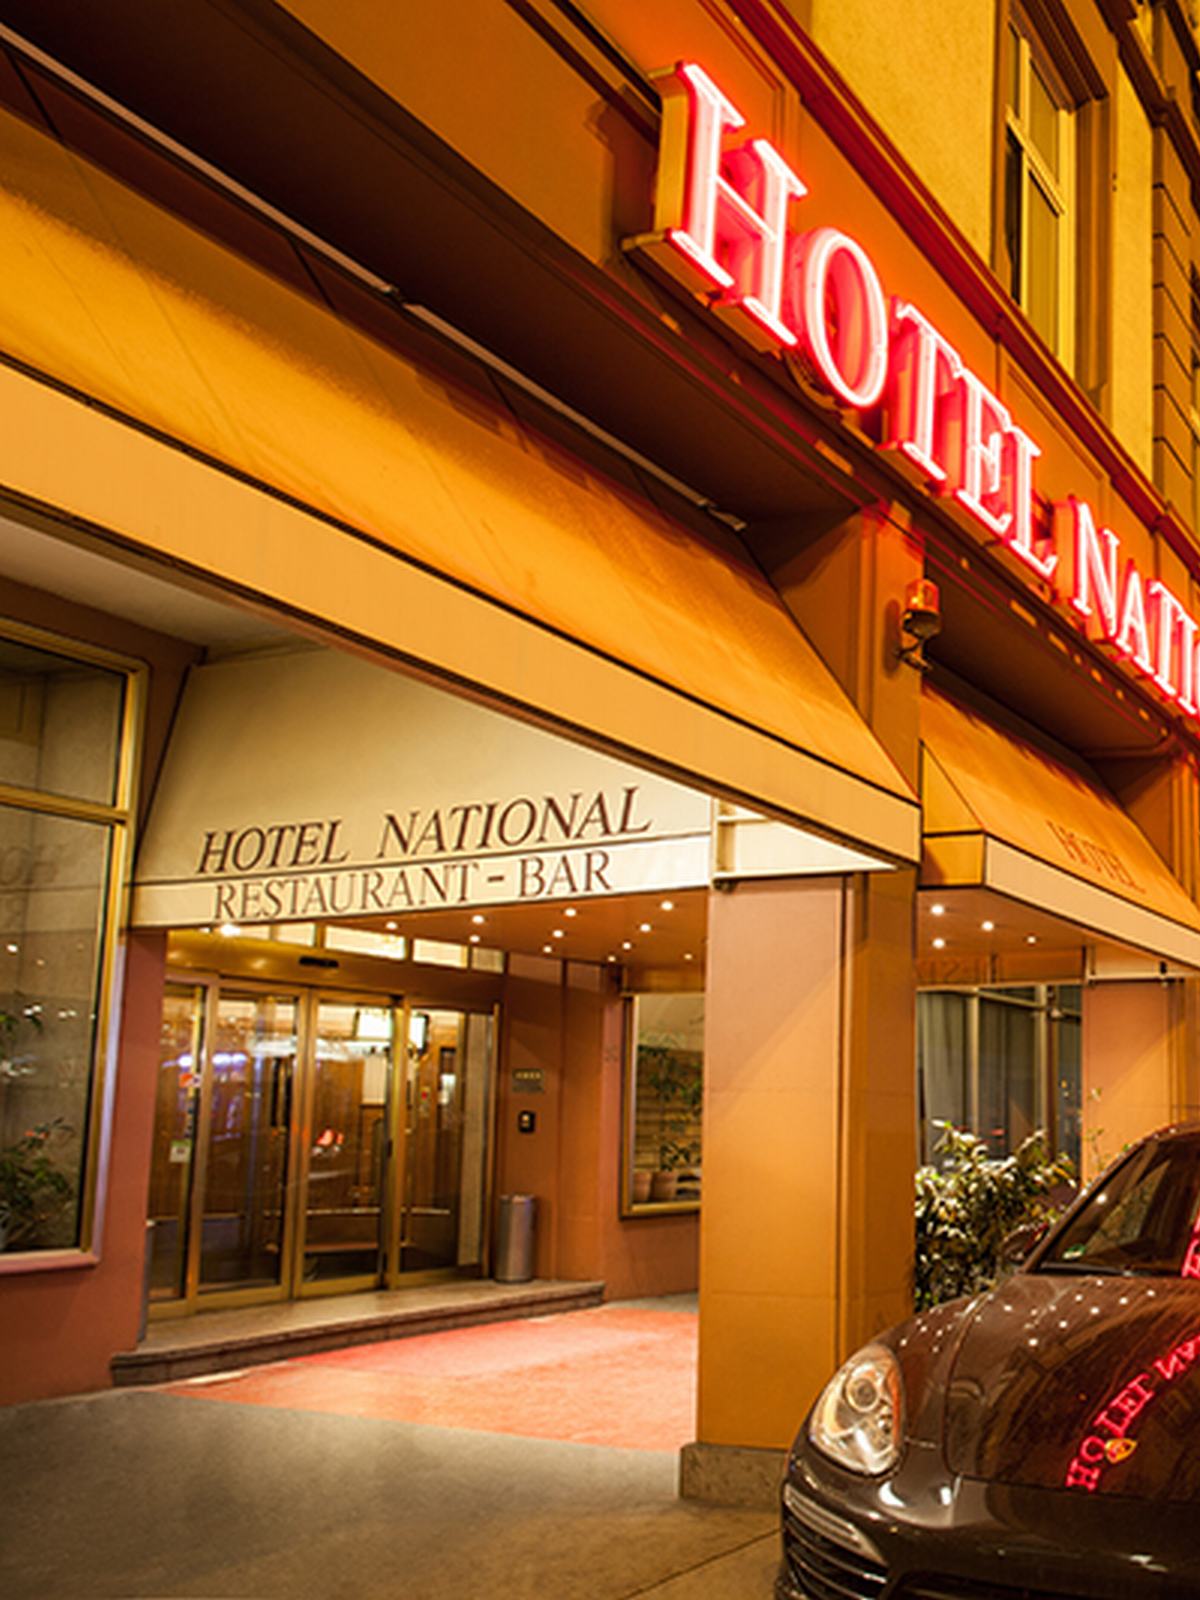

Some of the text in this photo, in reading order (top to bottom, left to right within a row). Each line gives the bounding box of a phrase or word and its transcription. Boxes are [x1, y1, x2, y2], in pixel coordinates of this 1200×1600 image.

[671, 63, 1057, 577] HOTEL
[196, 785, 652, 875] HOTEL NATIONAL
